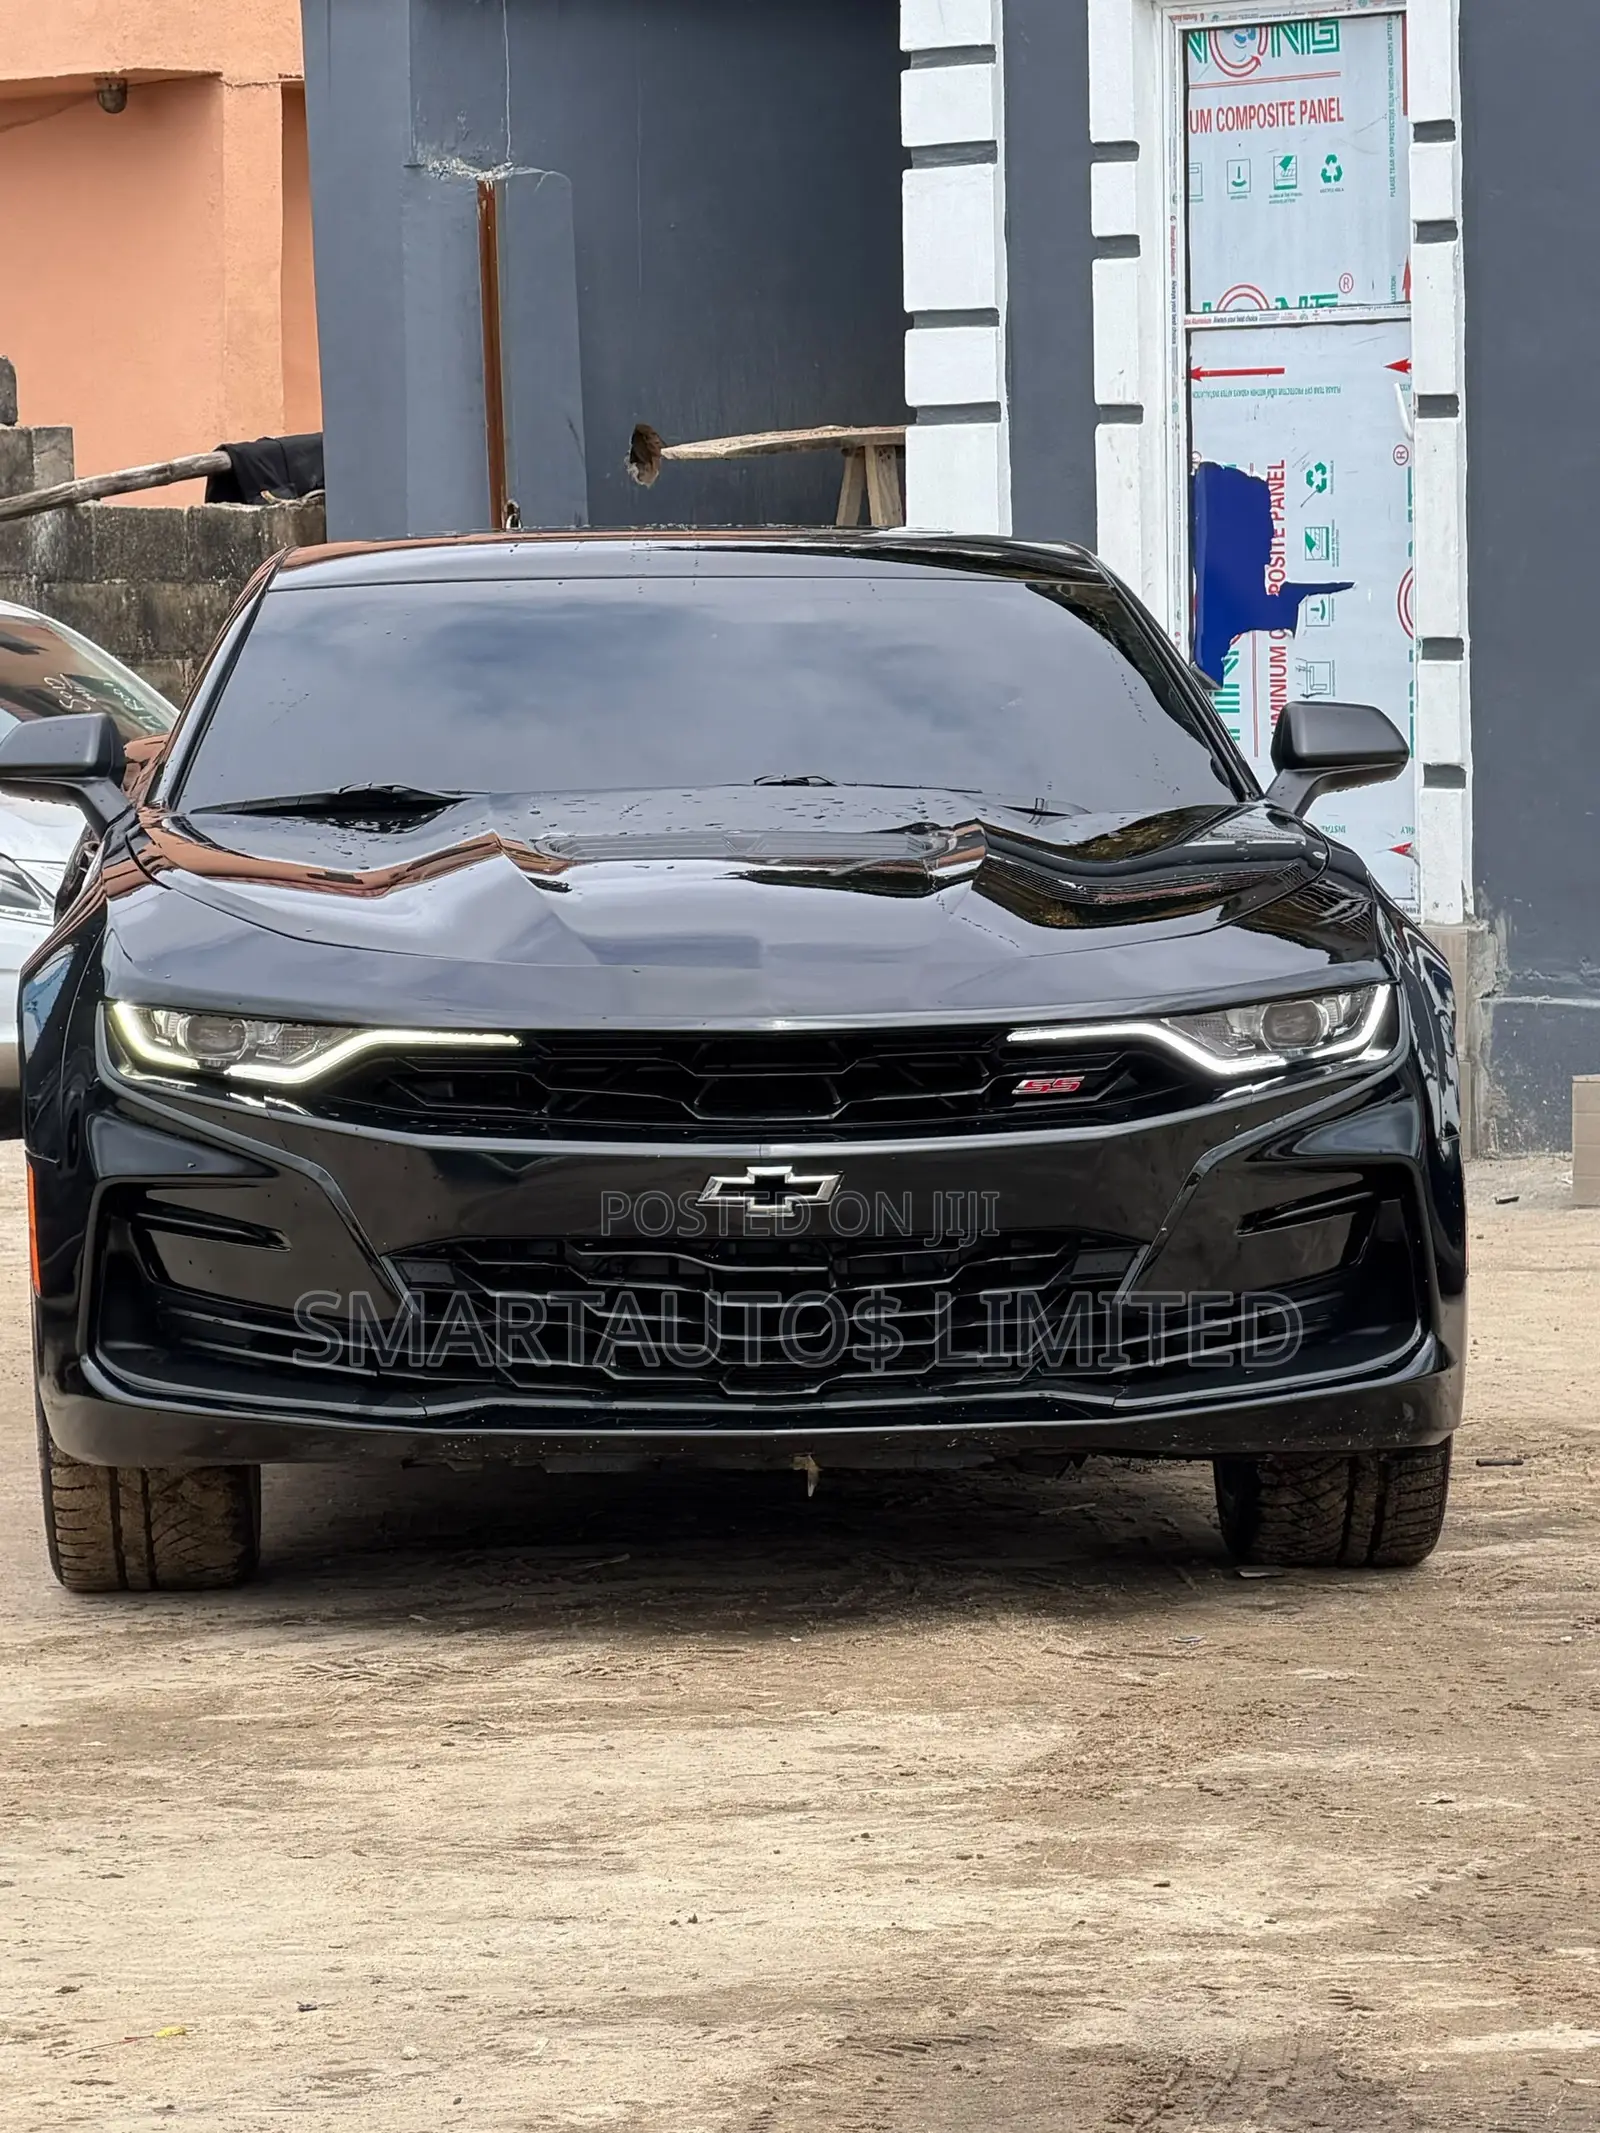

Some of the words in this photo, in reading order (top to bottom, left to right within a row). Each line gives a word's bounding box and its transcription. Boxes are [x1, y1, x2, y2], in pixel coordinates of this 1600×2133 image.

[1216, 101, 1296, 132] COMPOSITE
[1300, 97, 1344, 125] PANEL
[1011, 1075, 1086, 1095] SS
